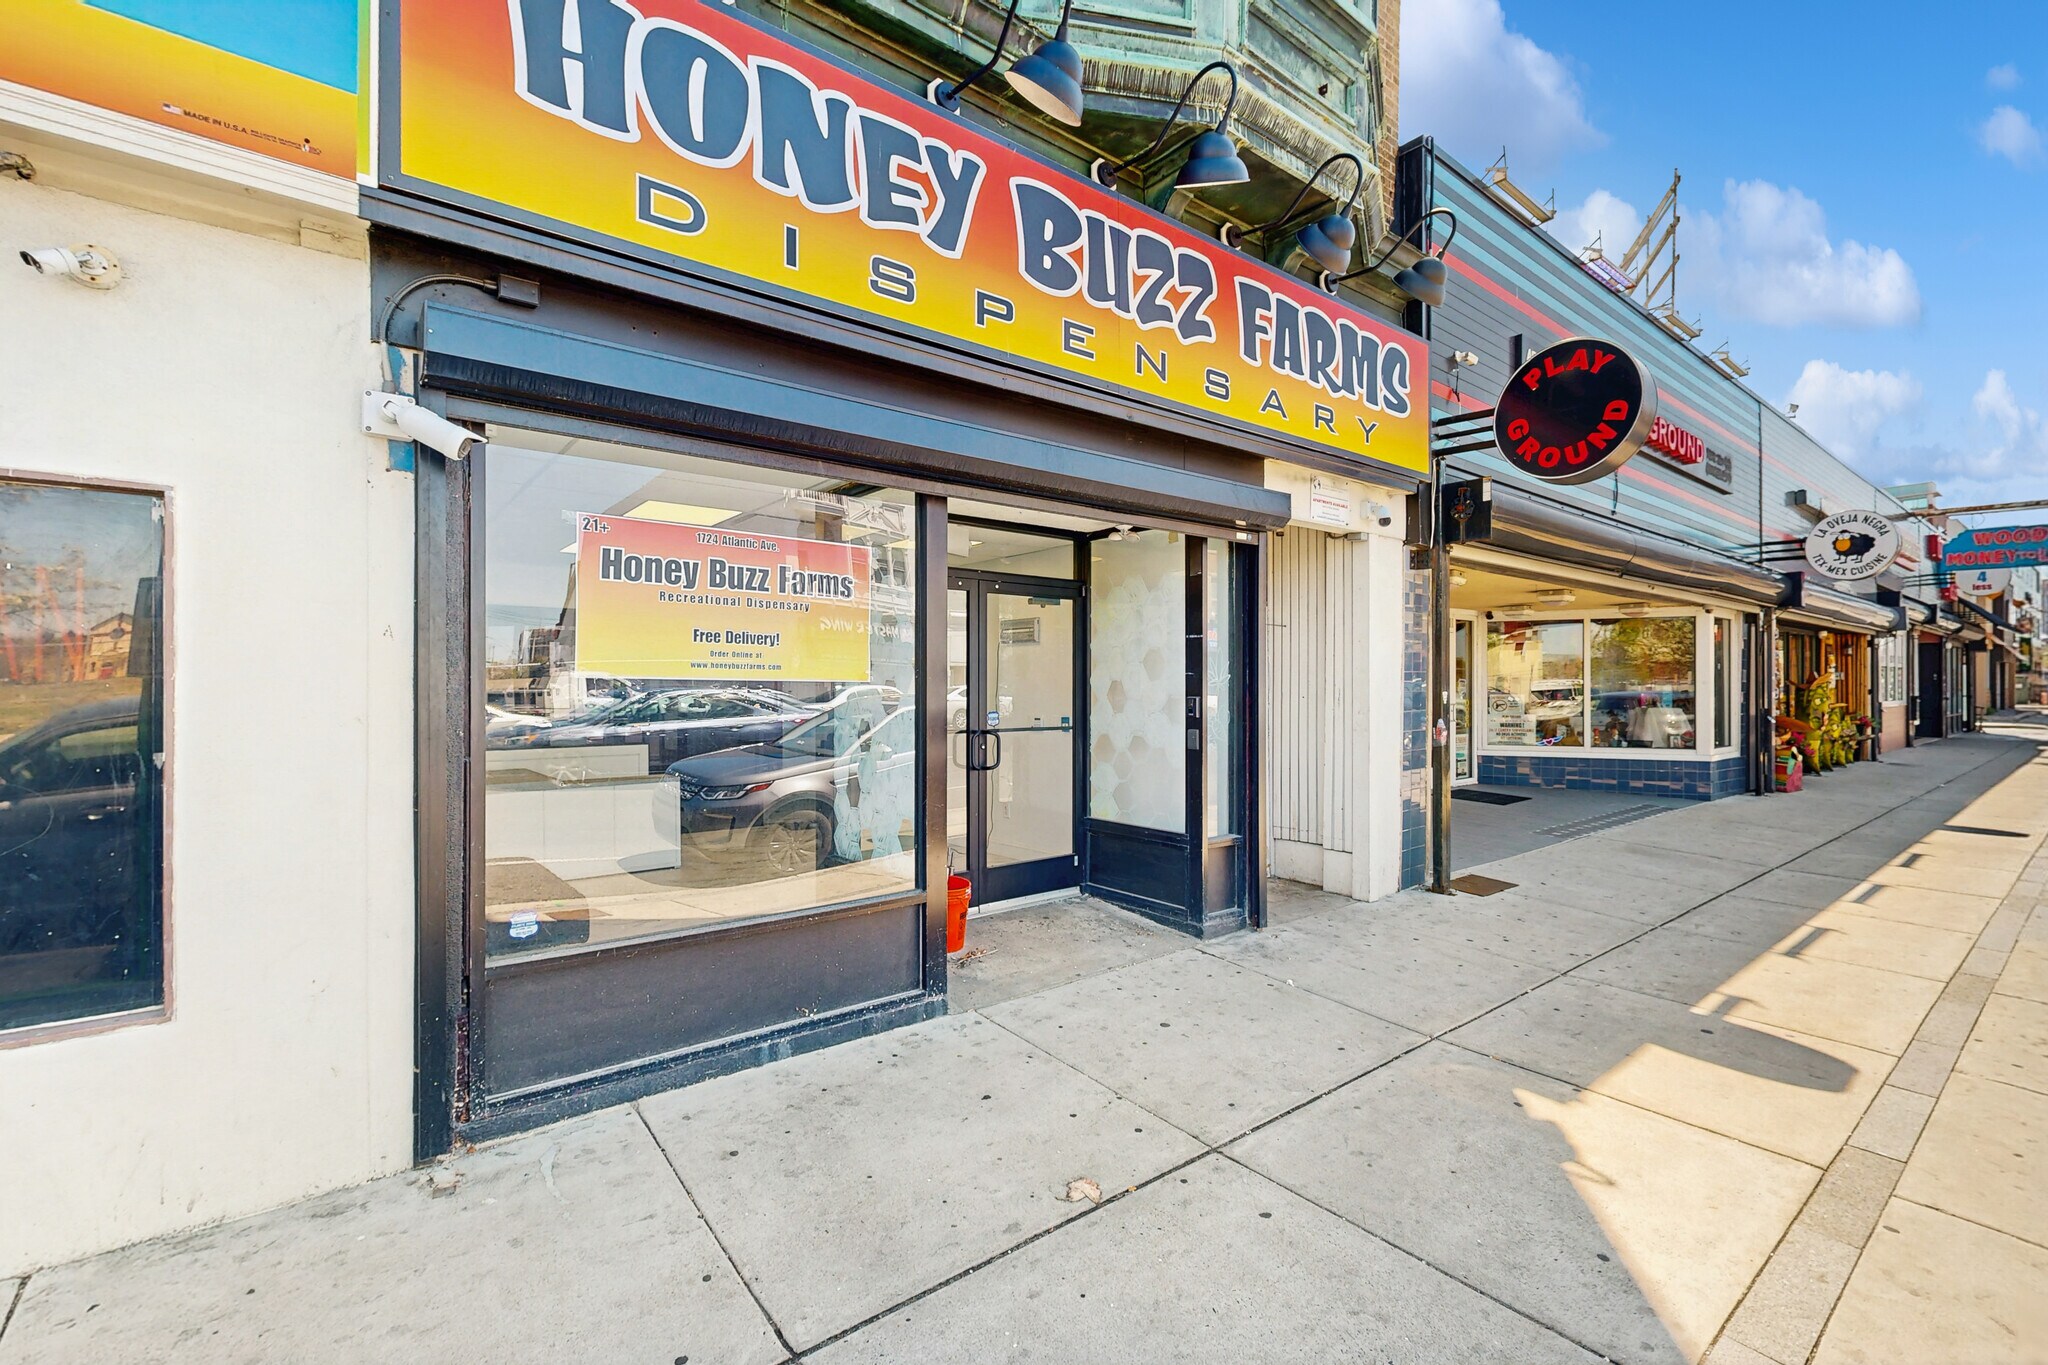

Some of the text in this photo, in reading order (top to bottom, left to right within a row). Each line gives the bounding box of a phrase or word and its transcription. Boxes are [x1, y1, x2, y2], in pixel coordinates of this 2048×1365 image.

[183, 110, 209, 122] MADE
[212, 118, 222, 126] IN
[507, 0, 1412, 419] HONEY BUZZ FARMS
[635, 172, 1381, 446] DISPENSARY
[1521, 348, 1616, 391] PLAY
[1507, 399, 1629, 468] GROUND
[582, 516, 611, 533] 21+
[1814, 513, 1891, 539] LA OVEJA NEGRA
[696, 532, 780, 552] 1724 Atlantic Ave.
[1812, 552, 1888, 576] TEX-MEX CUISINE
[1945, 548, 2016, 567] MONEY
[600, 546, 855, 601] Honey Buzz Farms
[1977, 571, 1987, 582] 4
[659, 590, 811, 613] Recreational Dispensary
[693, 628, 780, 647] Free Delivery!
[709, 650, 729, 658] Order
[731, 651, 753, 659] Online
[690, 662, 782, 671] www.honeybuzzfarms.com
